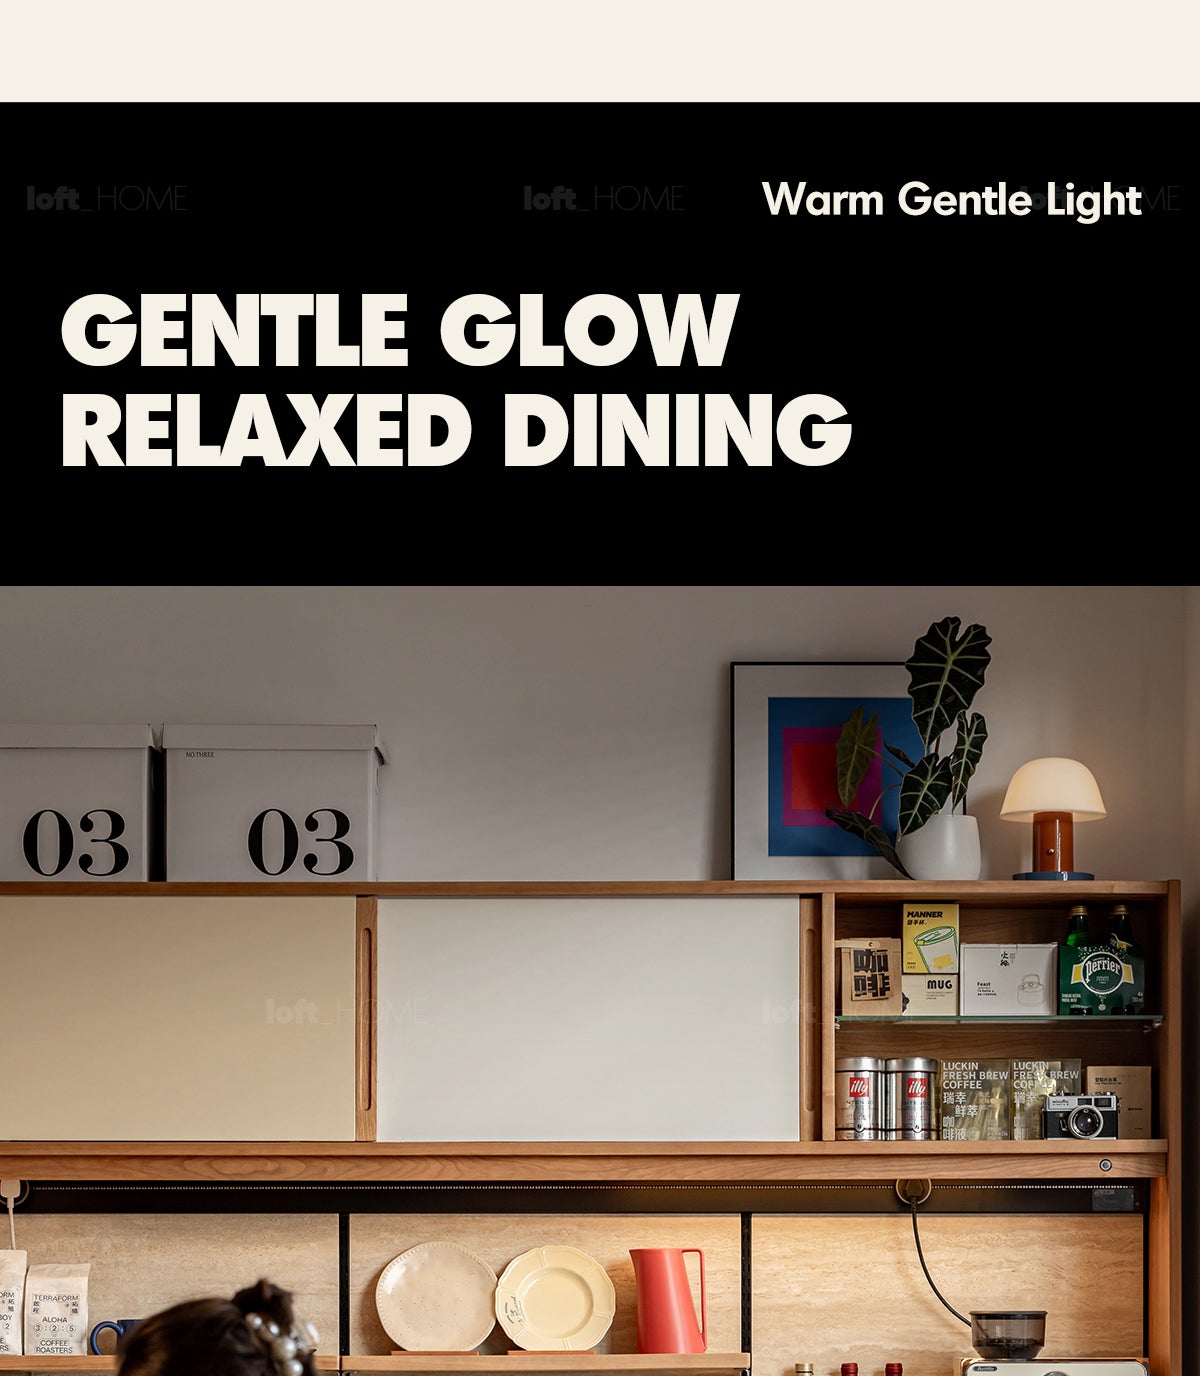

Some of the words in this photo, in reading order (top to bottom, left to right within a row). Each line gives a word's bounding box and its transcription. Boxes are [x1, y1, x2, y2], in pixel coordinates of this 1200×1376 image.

[22, 808, 130, 877] 03
[247, 808, 355, 876] 03
[906, 911, 944, 919] MANNER
[927, 979, 953, 990] MUG
[943, 1061, 979, 1070] LUCKIN
[943, 1071, 976, 1080] FRESH
[980, 1071, 1008, 1080] BREW
[1050, 1071, 1078, 1080] BREW
[850, 1079, 869, 1096] illy
[908, 1079, 926, 1097] illy
[943, 1080, 982, 1090] COFFEE
[943, 1092, 967, 1104] 瑞幸
[33, 1294, 79, 1302] TERRAFORM
[35, 1346, 73, 1354] ROASTERS
